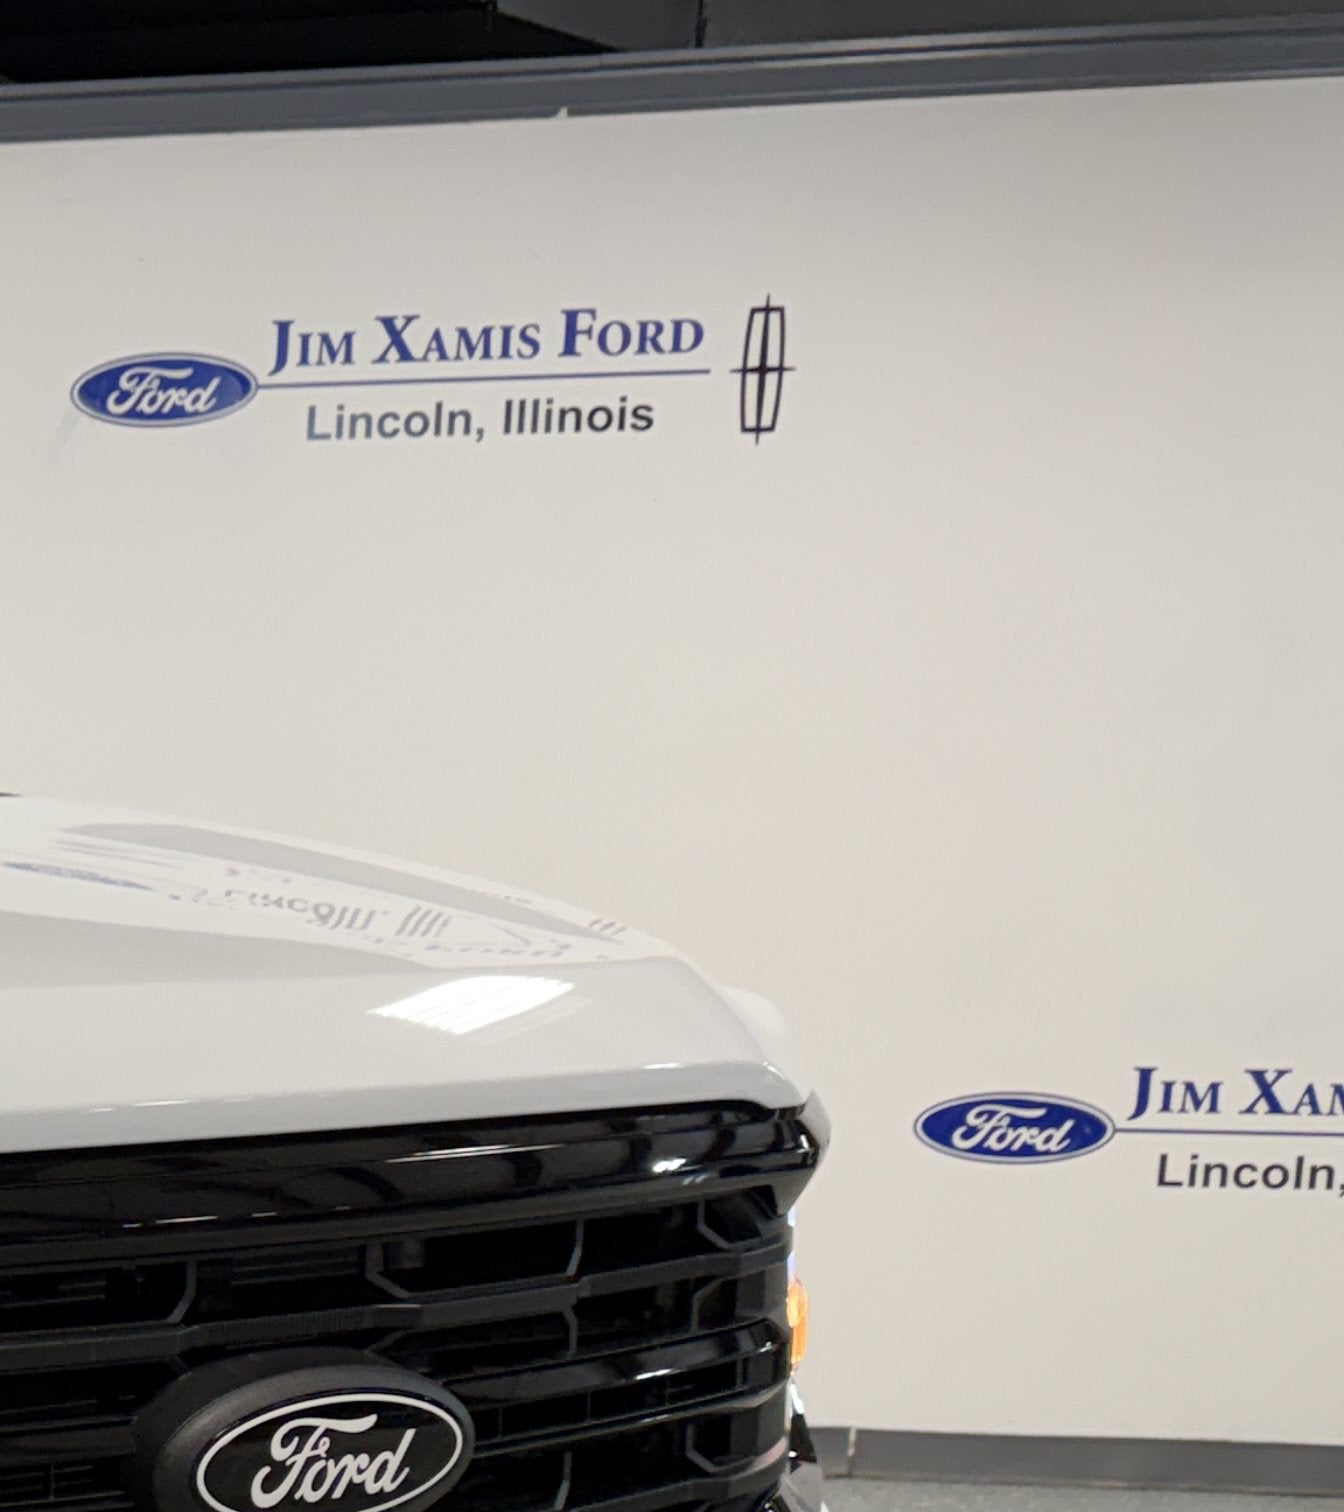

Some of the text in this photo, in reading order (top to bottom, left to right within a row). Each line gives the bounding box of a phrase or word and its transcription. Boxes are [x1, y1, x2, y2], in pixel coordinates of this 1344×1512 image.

[267, 307, 705, 376] JIM XAMIS FORD
[106, 365, 218, 415] Ford
[306, 396, 655, 442] Lincoln, Illinois
[1127, 1066, 1224, 1121] JIM
[950, 1103, 1075, 1153] Ford
[250, 1413, 417, 1509] Ford
